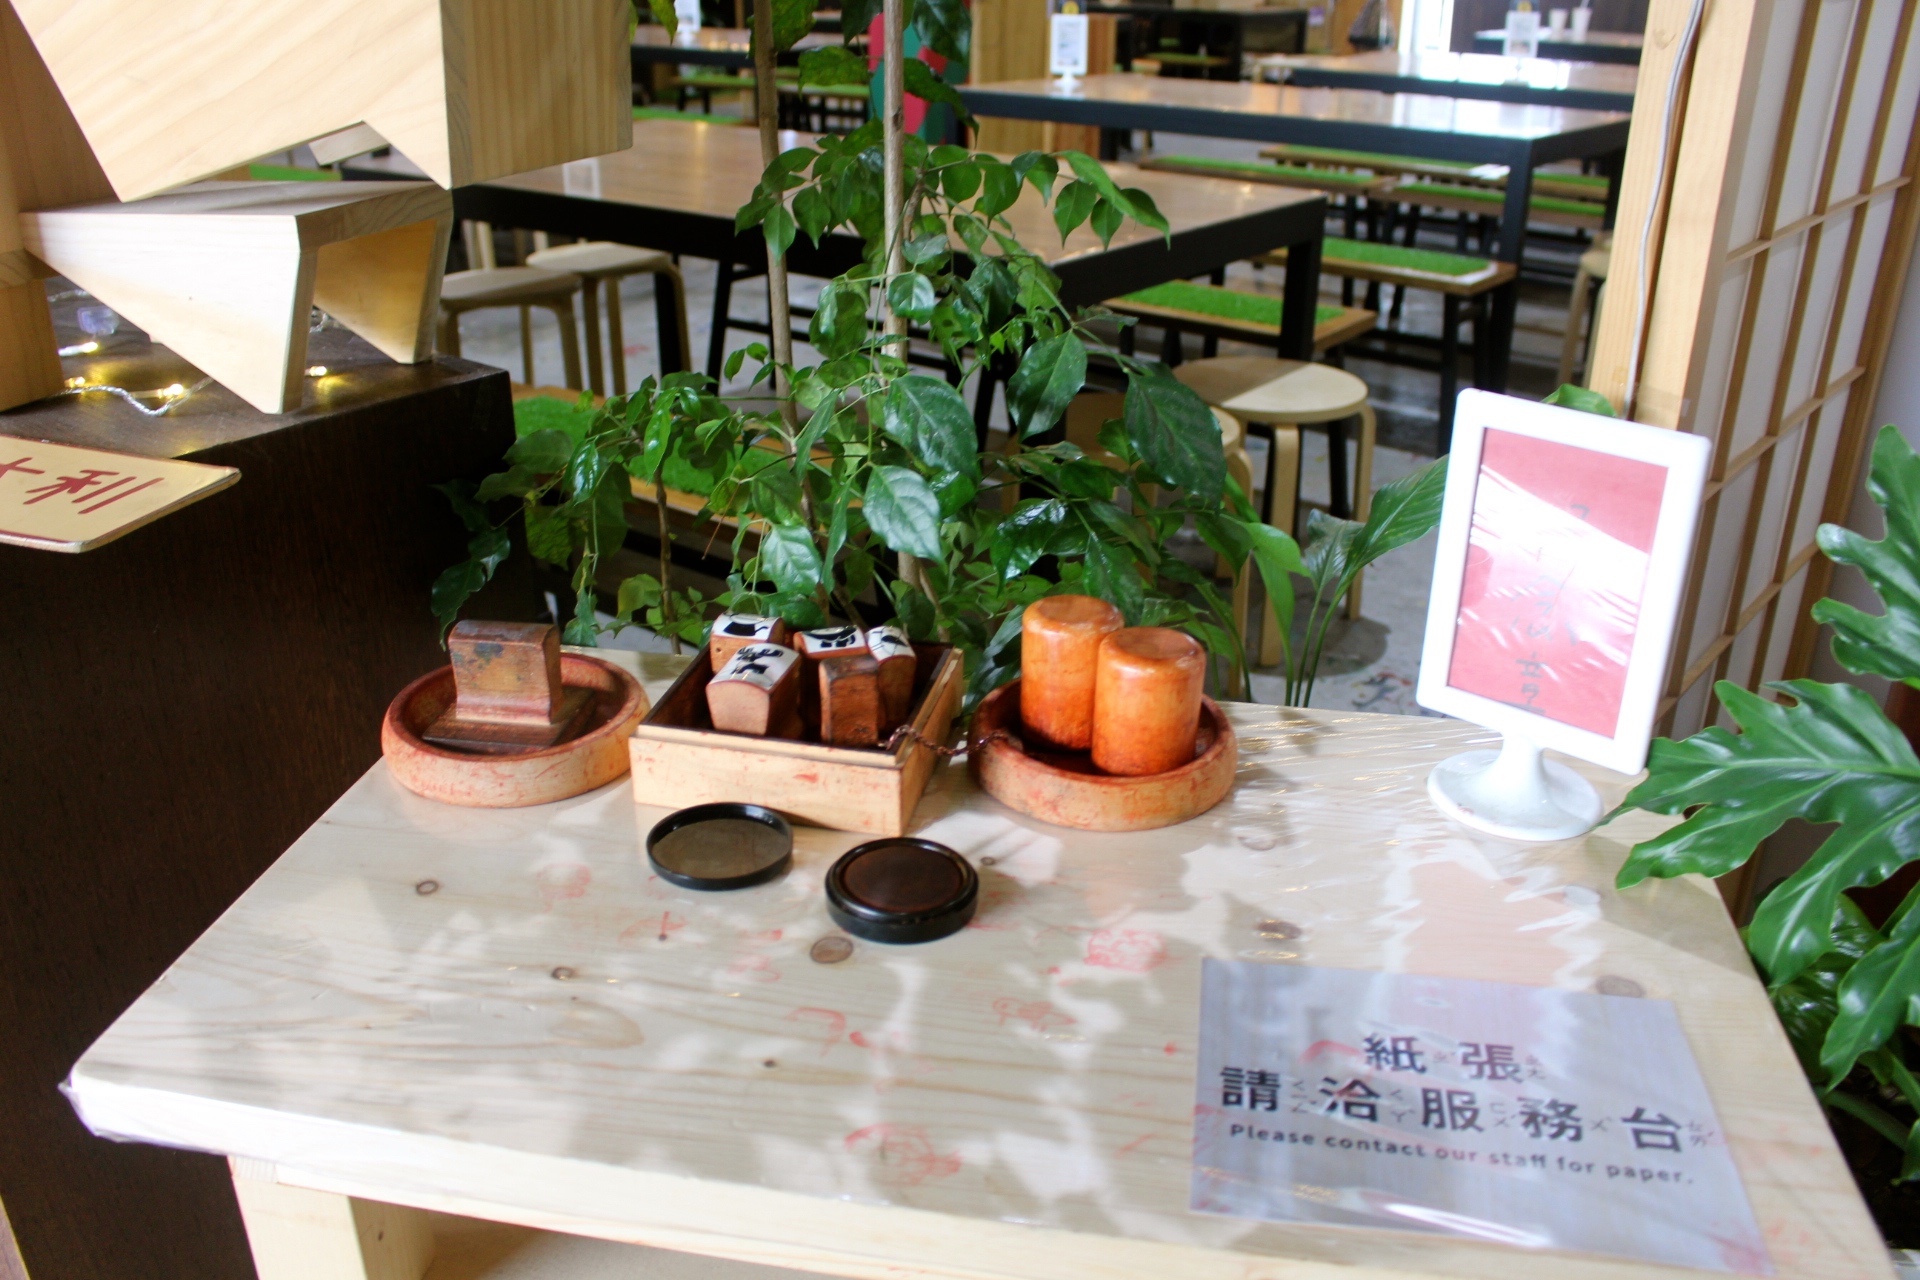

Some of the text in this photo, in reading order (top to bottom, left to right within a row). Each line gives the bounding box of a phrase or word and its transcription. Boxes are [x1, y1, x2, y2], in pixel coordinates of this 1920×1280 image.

[1364, 1033, 1525, 1084] 紙張
[1219, 1065, 1684, 1153] 請洽服務台
[1230, 1123, 1694, 1184] Please contact our staff for paper.
